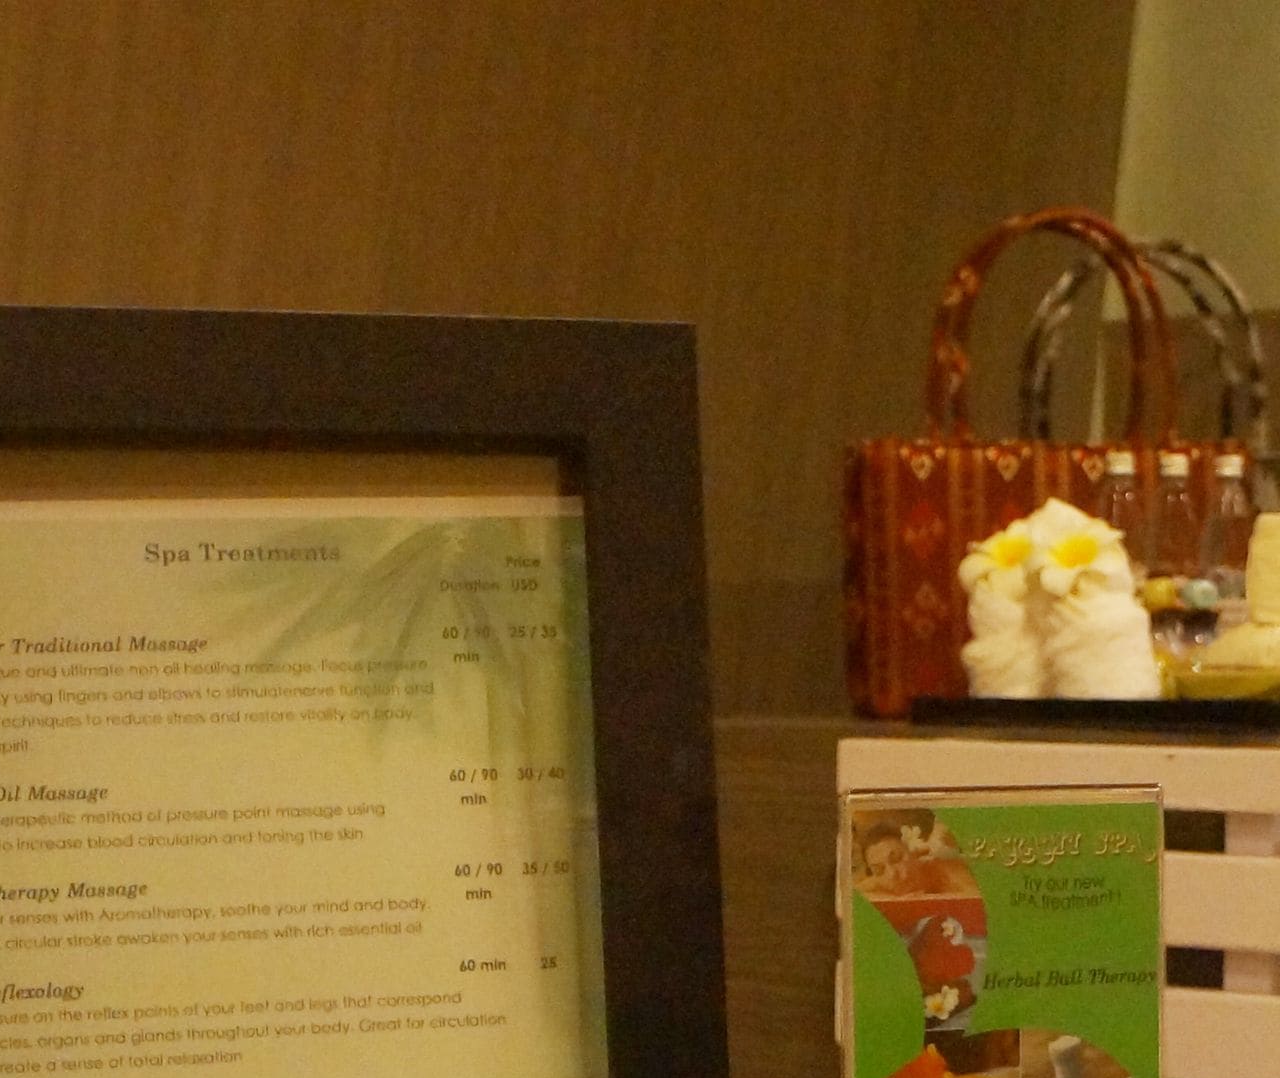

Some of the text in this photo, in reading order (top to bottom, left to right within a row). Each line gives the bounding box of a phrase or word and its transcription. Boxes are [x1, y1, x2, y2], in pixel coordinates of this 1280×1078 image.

[144, 542, 340, 565] Spa Treatments
[442, 627, 459, 641] 60
[13, 636, 120, 656] Traditional
[129, 636, 208, 654] Massage
[453, 651, 480, 664] min
[449, 769, 466, 782] 60
[481, 768, 498, 781] 90
[28, 784, 109, 801] Massage
[461, 793, 487, 805] min
[454, 864, 471, 877] 60
[487, 863, 503, 876] 90
[68, 882, 147, 900] Massage
[465, 888, 492, 900] min
[9, 912, 58, 925] senses
[63, 909, 94, 923] with
[220, 902, 270, 917] soothe
[276, 903, 307, 917] your
[311, 900, 348, 913] mind
[354, 899, 383, 912] and
[5, 935, 62, 950] circular
[66, 933, 111, 947] stroke
[117, 932, 178, 945] awaken
[182, 931, 216, 945] your
[221, 927, 269, 940] senses
[274, 924, 302, 938] with
[307, 923, 334, 937] rich
[338, 921, 401, 936] essential
[459, 959, 476, 972] 60
[481, 959, 506, 971] min
[983, 971, 1041, 990] Herbal
